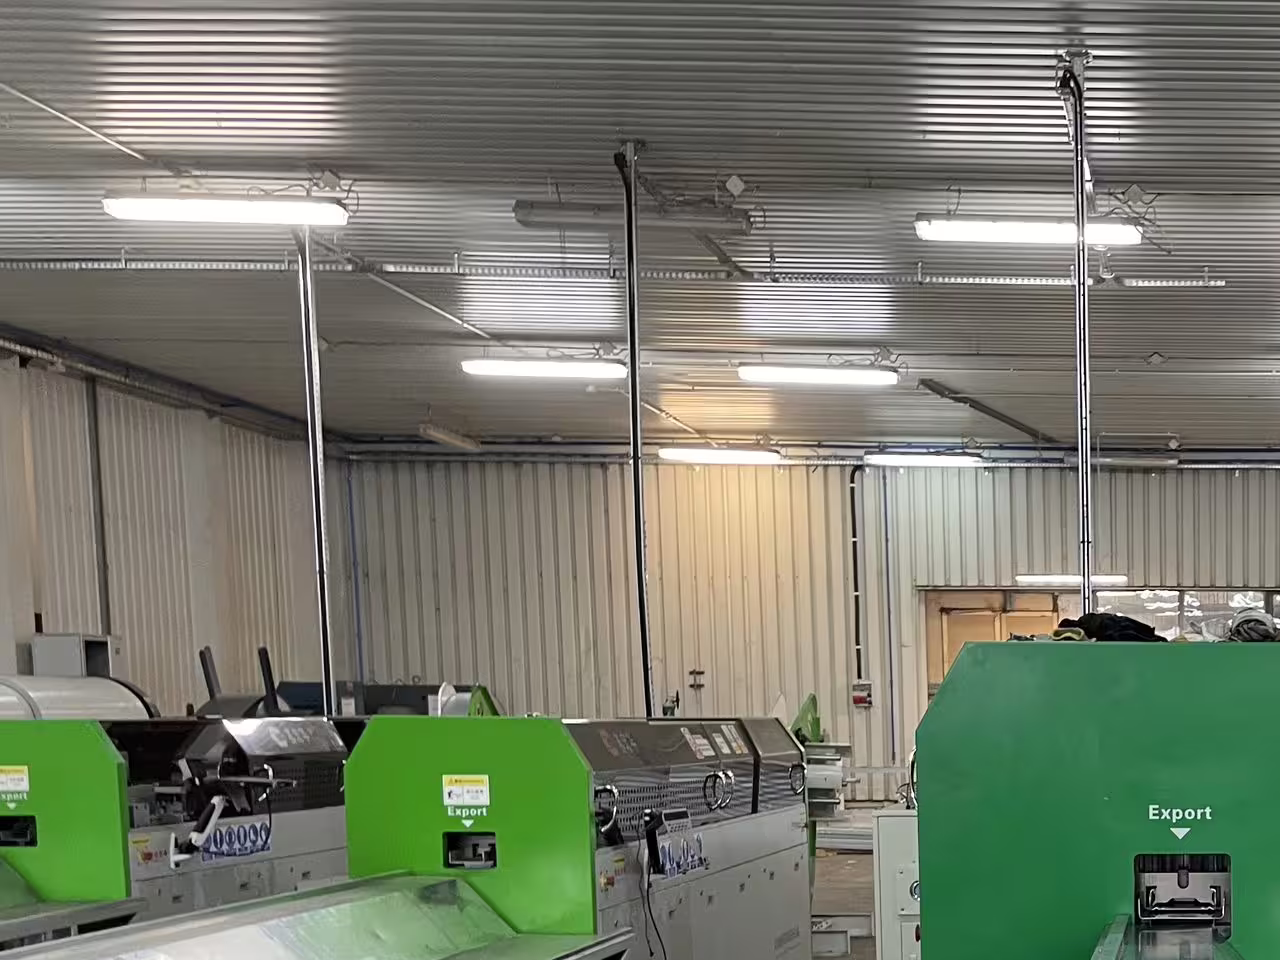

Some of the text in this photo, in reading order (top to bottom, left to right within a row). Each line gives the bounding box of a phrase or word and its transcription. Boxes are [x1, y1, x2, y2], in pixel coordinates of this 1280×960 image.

[0, 792, 28, 801] xport
[447, 806, 488, 818] Export
[1148, 804, 1212, 823] Export
